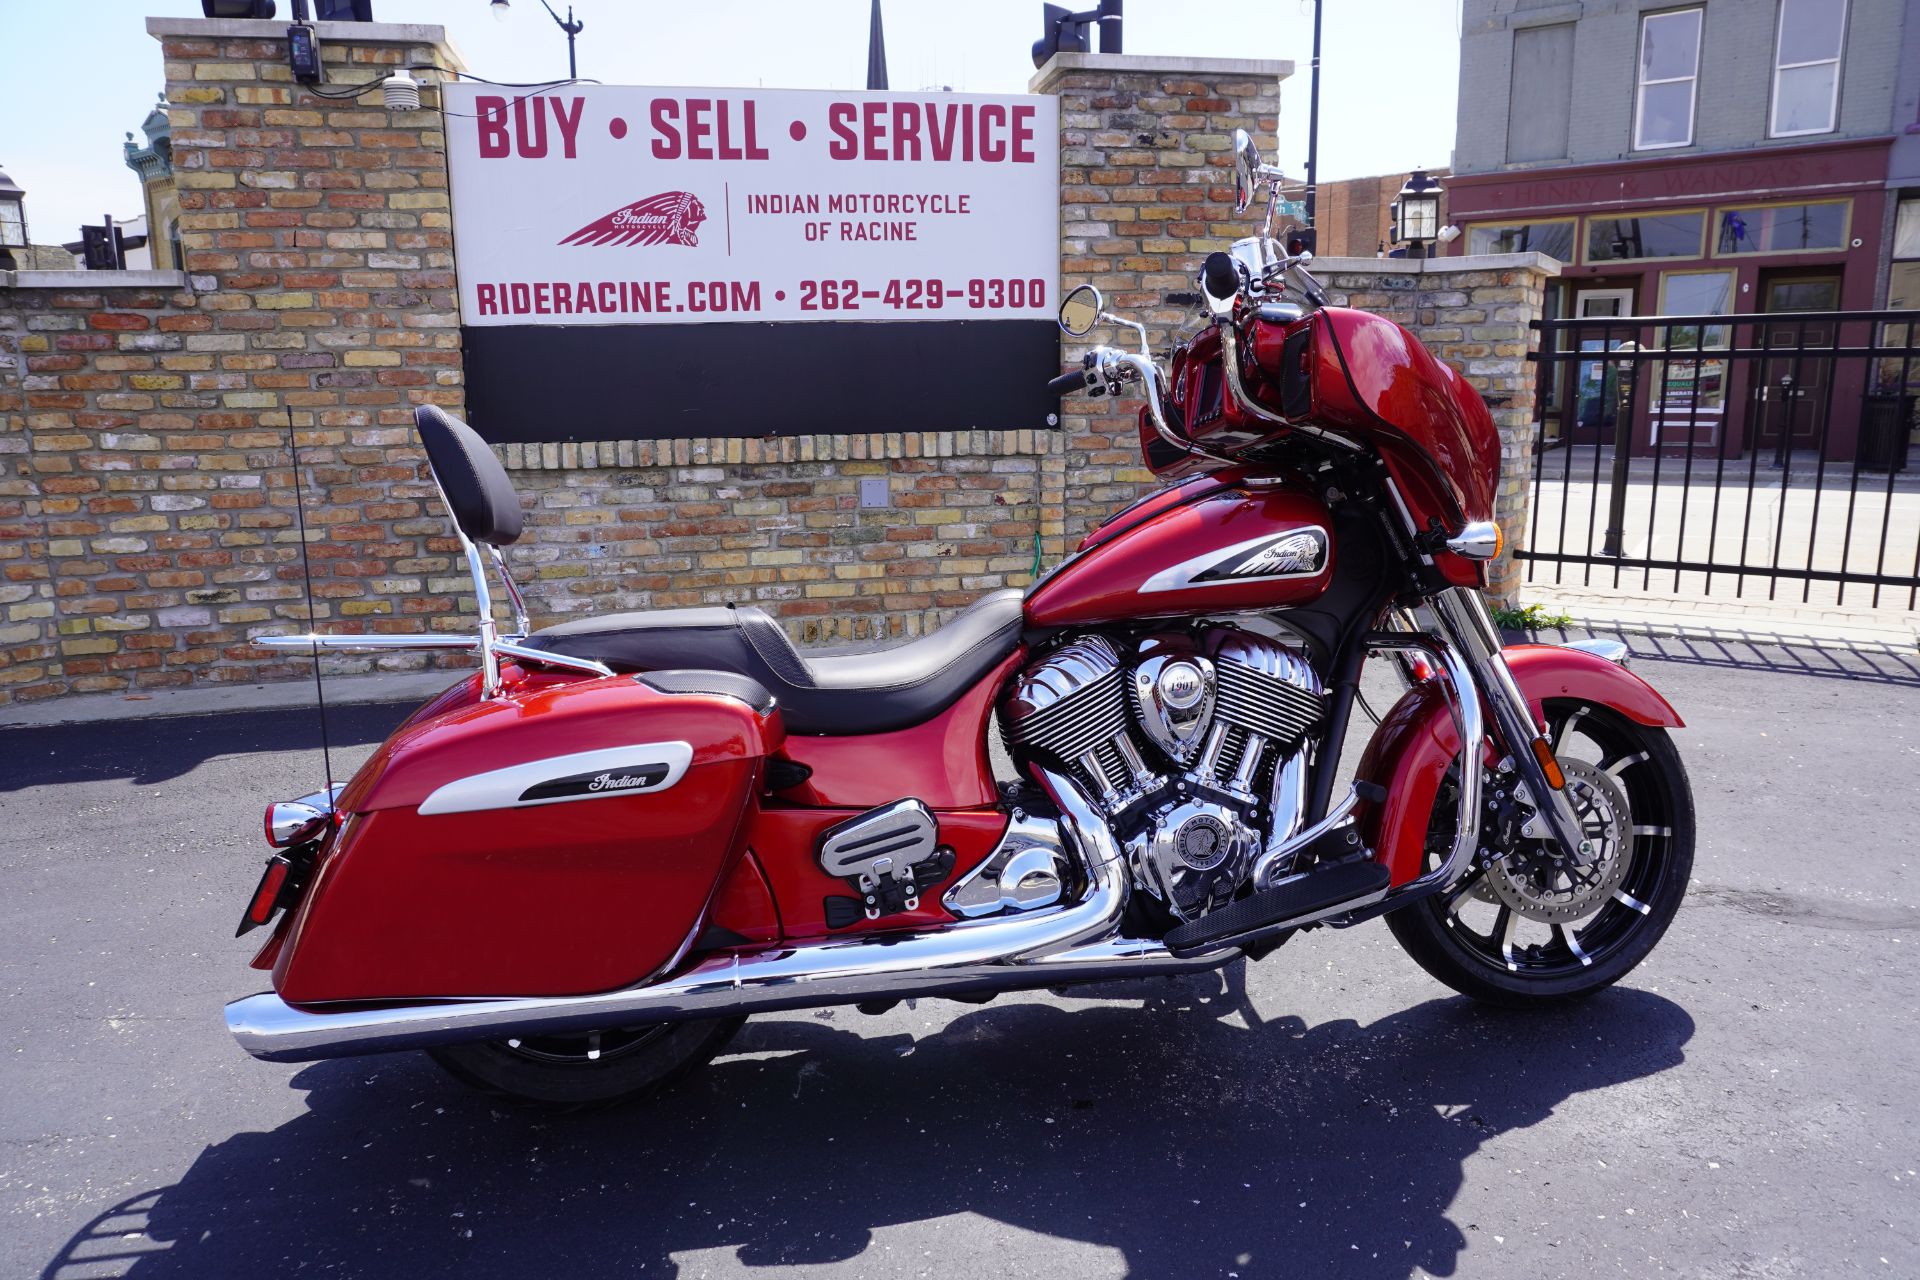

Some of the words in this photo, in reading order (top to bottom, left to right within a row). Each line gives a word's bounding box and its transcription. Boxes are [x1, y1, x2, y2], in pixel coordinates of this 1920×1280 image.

[476, 96, 585, 159] BUY
[650, 99, 769, 160] SELL
[829, 103, 1035, 163] SERVICE
[1514, 180, 1600, 203] HENRY
[1663, 162, 1804, 193] WANDA'S
[748, 195, 819, 214] INDIAN
[829, 195, 970, 213] MOTORCYCLE
[611, 208, 668, 225] Indian
[805, 222, 830, 241] OF
[840, 222, 917, 241] RACINE
[477, 281, 761, 316] RIDERACINE.COM
[800, 278, 1046, 311] 262-429-9300
[1263, 548, 1298, 559] Indian
[1171, 680, 1193, 692] 1901
[588, 773, 647, 791] Indian
[1191, 817, 1227, 854] MOTORCYCLE
